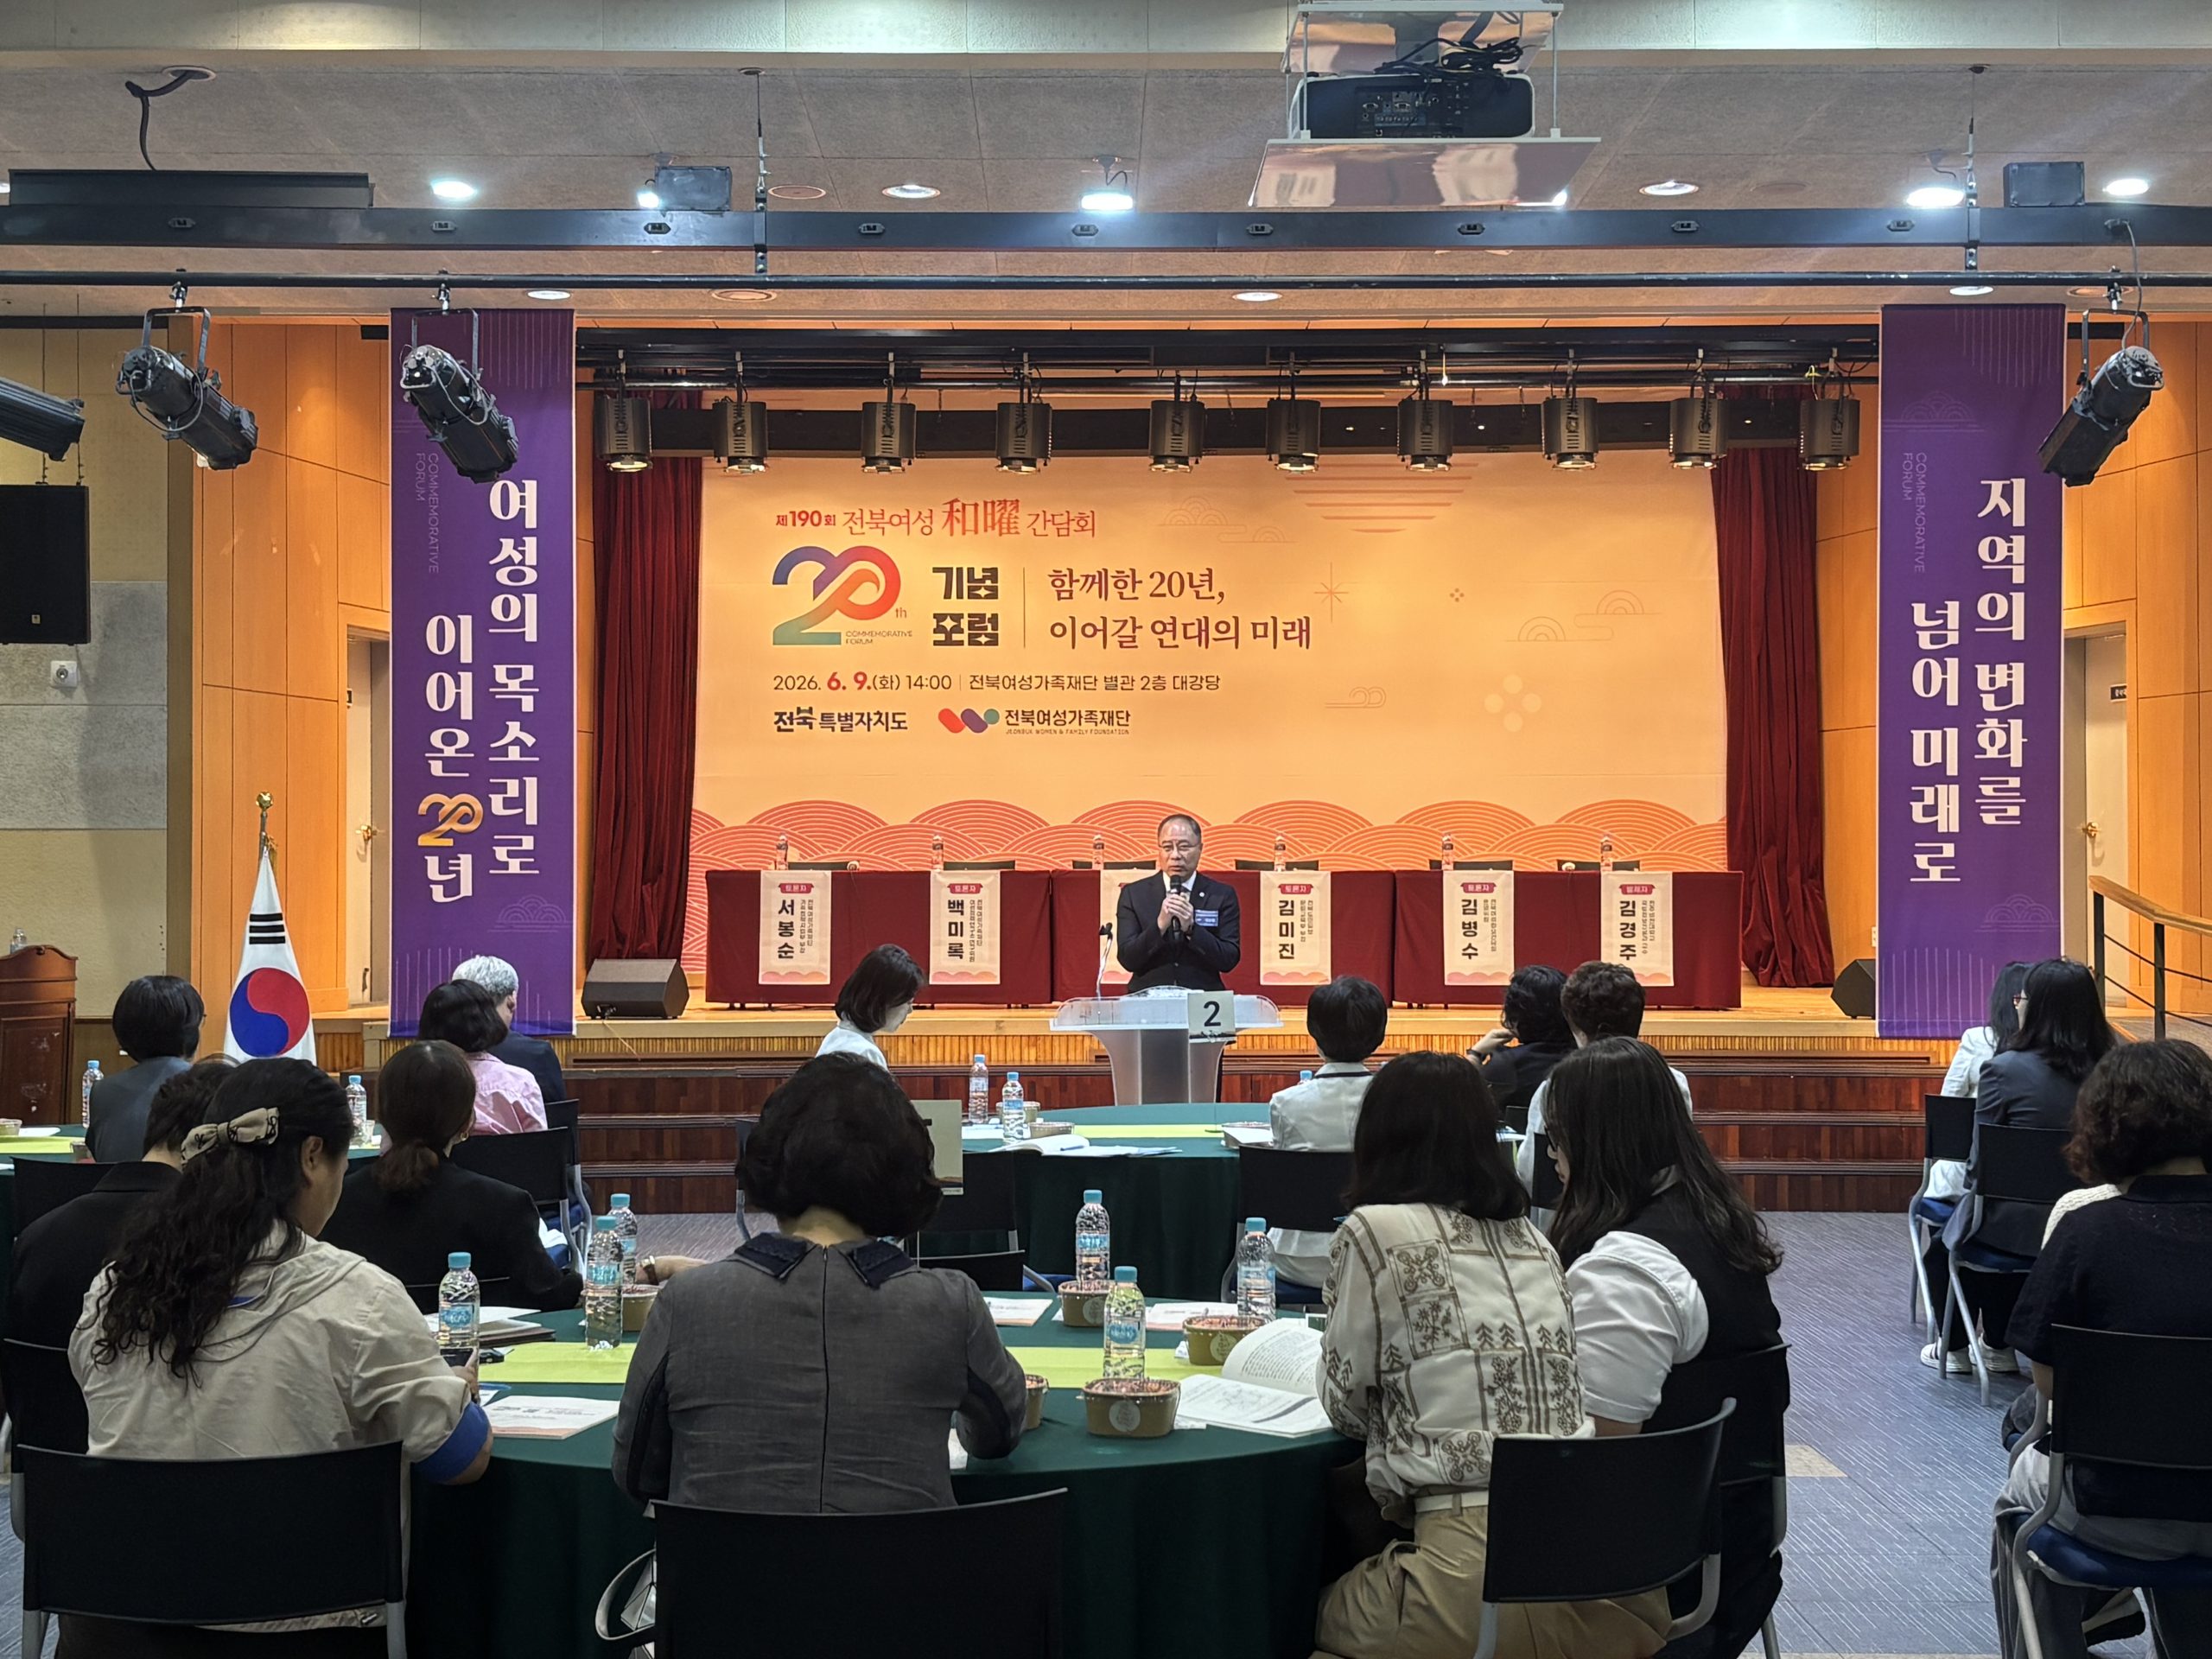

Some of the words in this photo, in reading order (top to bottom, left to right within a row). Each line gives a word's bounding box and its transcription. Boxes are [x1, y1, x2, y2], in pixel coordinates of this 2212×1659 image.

[416, 452, 426, 501] FORUM
[1902, 452, 1913, 501] FORUM
[429, 452, 440, 574] COMMEMORATIVE
[775, 509, 836, 528] 제190회
[842, 508, 934, 537] 전북여성
[941, 497, 1021, 537] 和曜
[1026, 510, 1096, 537] 간담회
[1914, 452, 1927, 574] COMMEMORATIVE
[489, 480, 538, 642] 여성의
[931, 567, 999, 600] 기념
[1046, 567, 1142, 601] 함께한
[1148, 568, 1225, 605] 20년,
[1975, 478, 2025, 641] 지역의
[931, 613, 999, 646] 포럼
[1049, 615, 1143, 650] 이어갈
[1150, 615, 1241, 650] 연대의
[1249, 615, 1312, 650] 미래
[1910, 601, 1960, 706] 넘어
[424, 614, 474, 778] 이어온
[772, 675, 822, 690] 2026.
[906, 674, 952, 690] 14:00
[969, 674, 1098, 691] 전북여성가족재단
[1103, 674, 1135, 691] 별관
[1140, 674, 1167, 691] 2층
[1173, 674, 1221, 691] 대강당
[1004, 709, 1132, 727] 전북여성가족재단
[1974, 662, 2028, 825] 변화를
[489, 664, 540, 874] 목소리로
[1909, 728, 1961, 882] 미래로
[778, 899, 795, 959] 서봉순
[947, 899, 964, 960] 백미록
[1278, 899, 1295, 960] 김미진
[1461, 899, 1478, 960] 김병수
[1619, 899, 1637, 961] 김경주
[1203, 1001, 1222, 1027] 2
